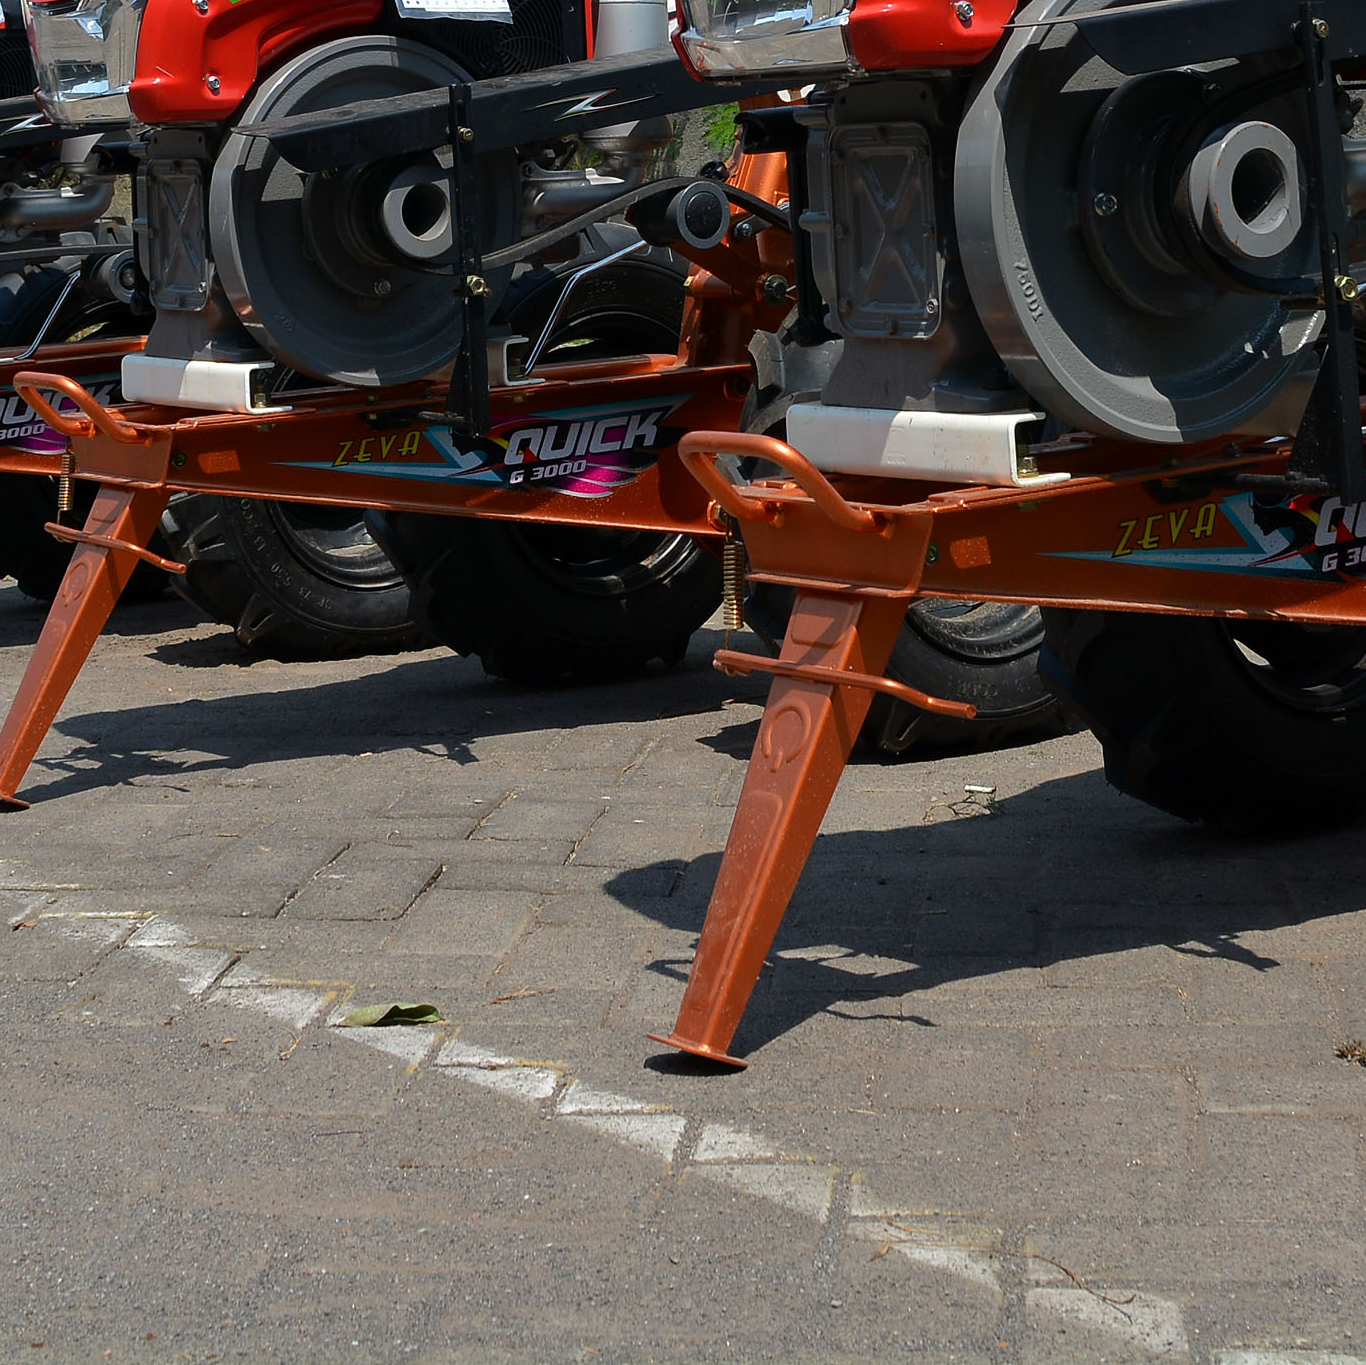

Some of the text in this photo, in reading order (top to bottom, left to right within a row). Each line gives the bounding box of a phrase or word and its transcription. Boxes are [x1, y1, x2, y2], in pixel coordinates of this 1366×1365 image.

[332, 411, 666, 468] ZEVA QUICK
[508, 459, 588, 484] G 3000
[1112, 502, 1218, 559] ZEVA
[1321, 554, 1339, 573] G
